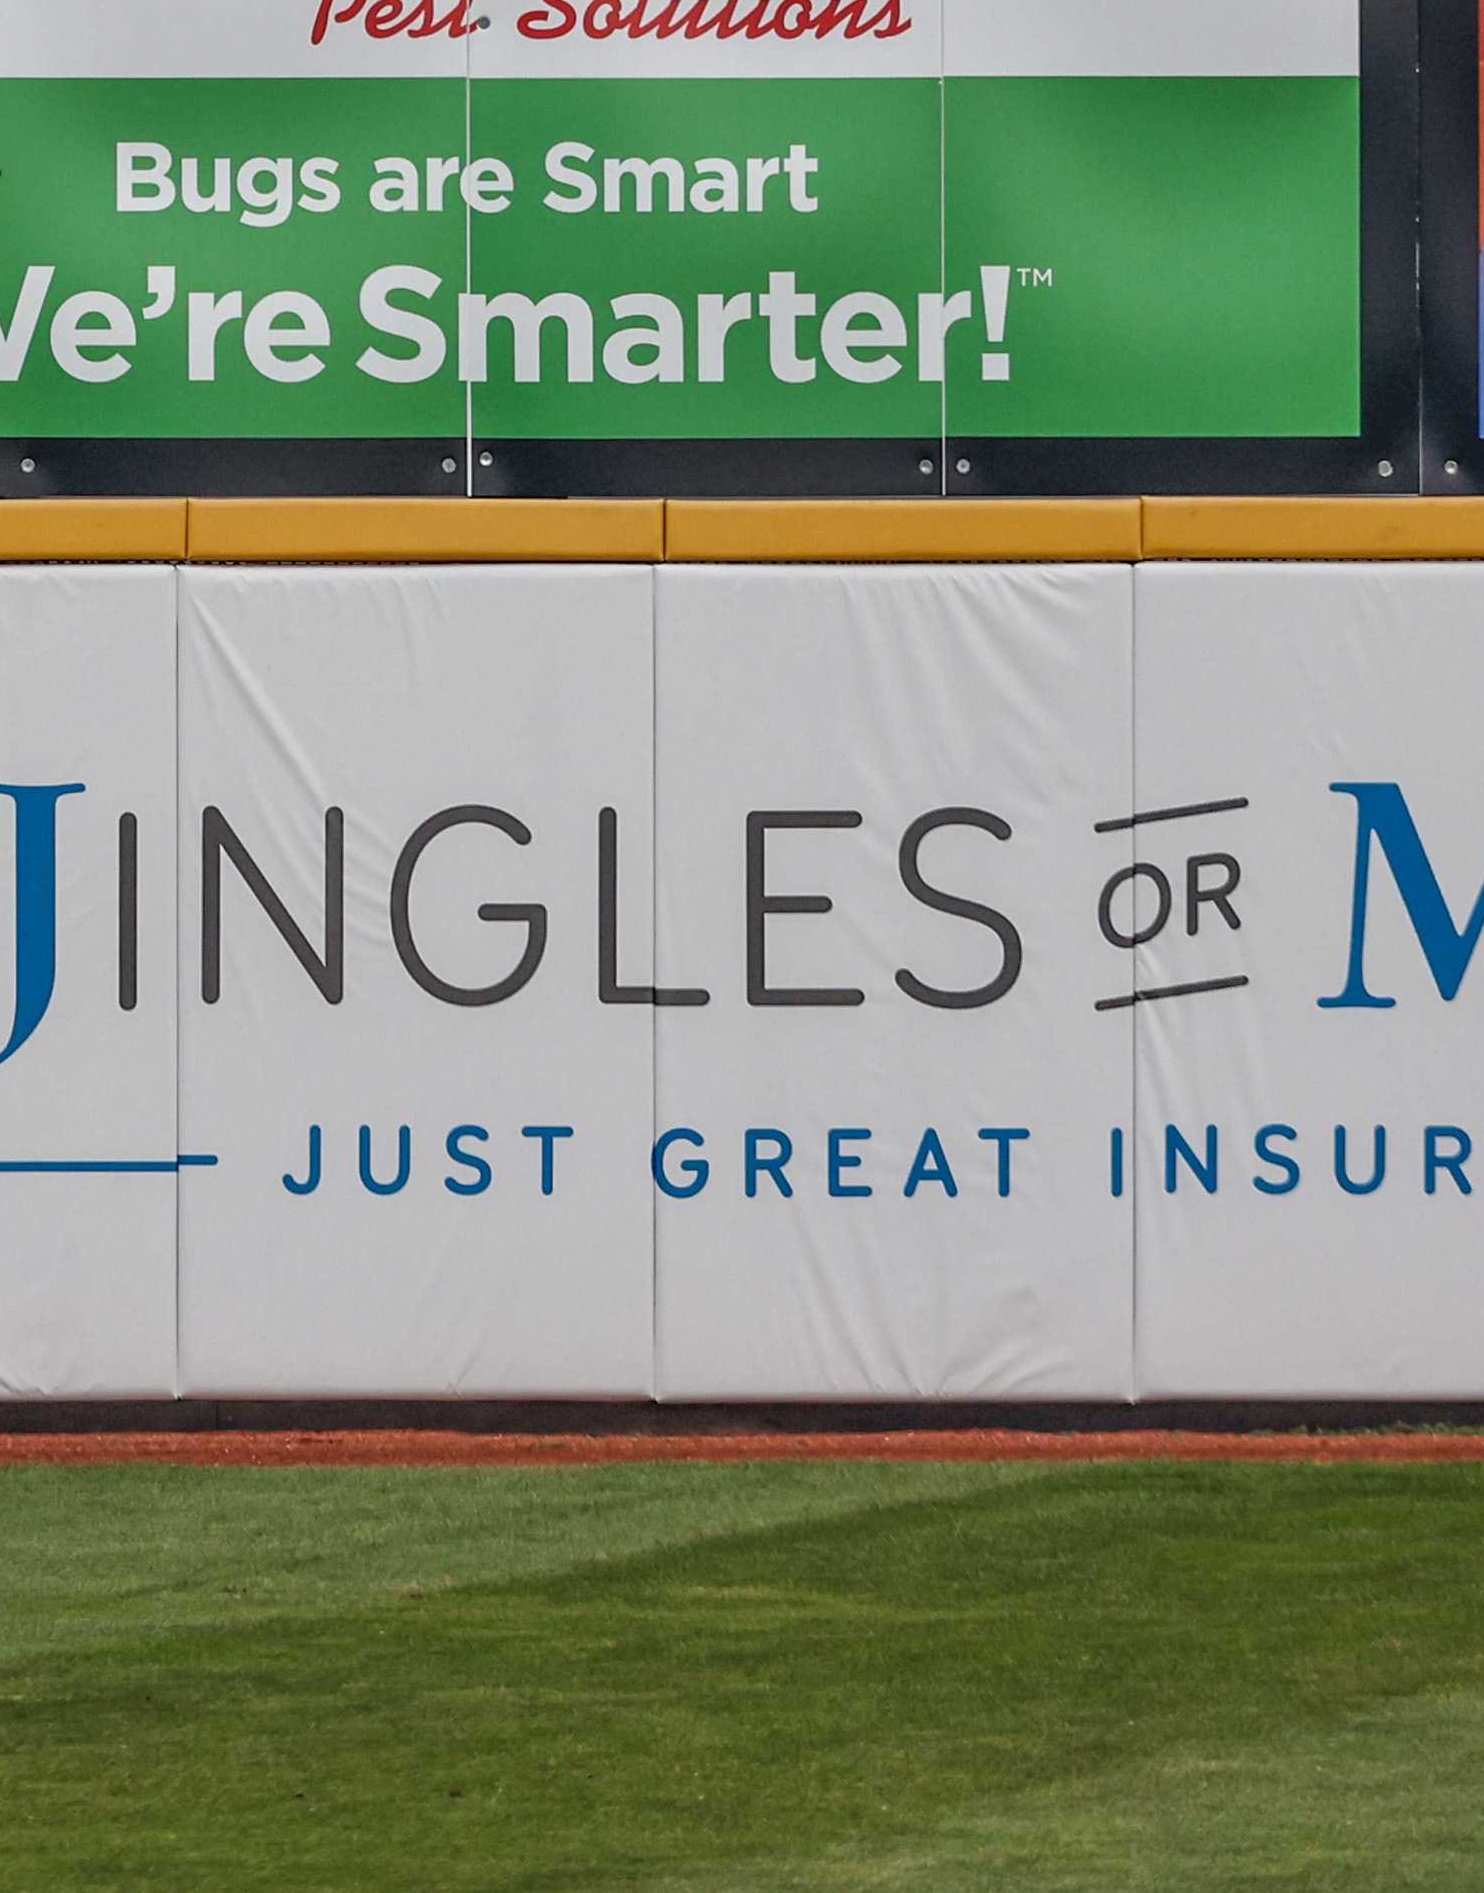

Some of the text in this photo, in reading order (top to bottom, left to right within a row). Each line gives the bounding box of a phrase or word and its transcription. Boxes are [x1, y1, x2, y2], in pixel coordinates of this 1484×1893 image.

[117, 142, 818, 227] Bugs are Smart
[1098, 853, 1241, 949] OR
[283, 1125, 573, 1195] JUST
[651, 1128, 1030, 1198] GREAT
